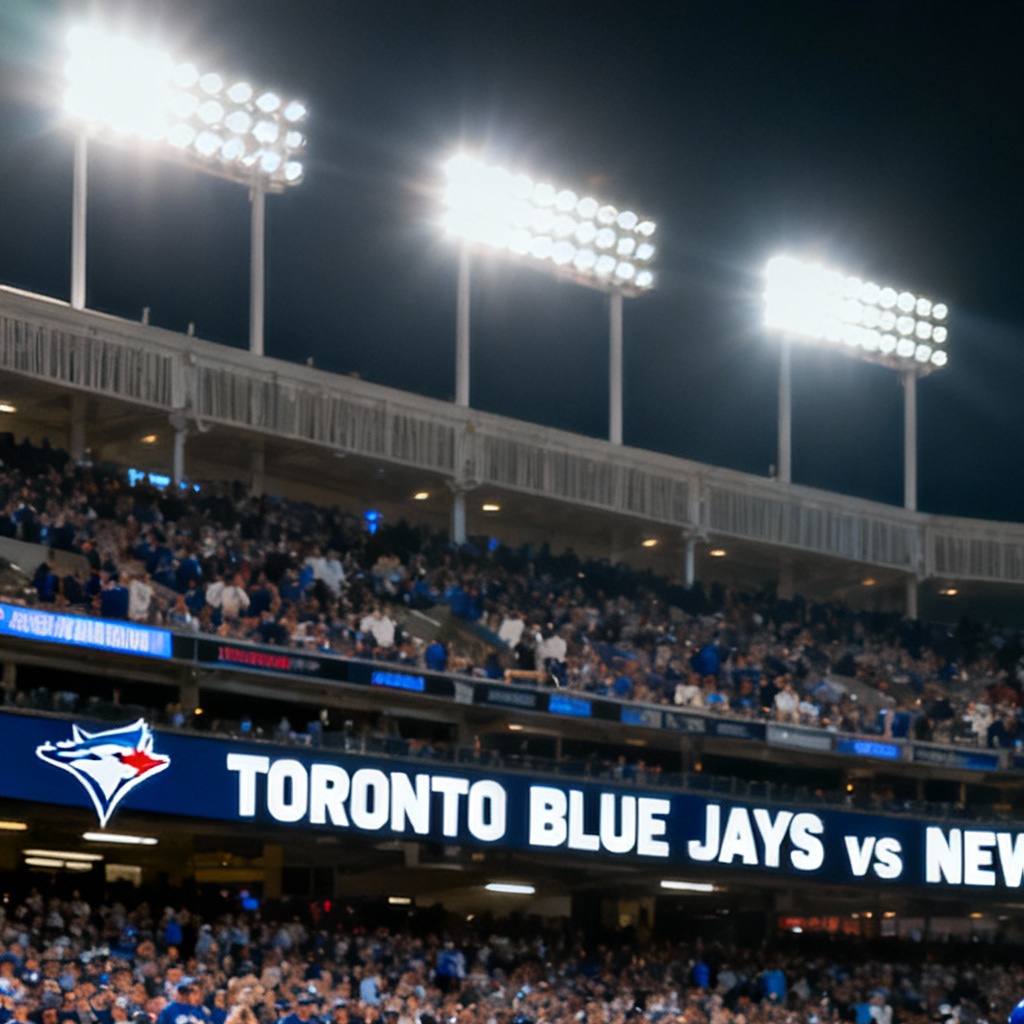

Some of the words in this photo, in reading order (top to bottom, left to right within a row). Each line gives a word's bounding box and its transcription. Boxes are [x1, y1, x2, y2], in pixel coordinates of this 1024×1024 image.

[226, 752, 507, 842] TORONTO
[529, 786, 670, 857] BLUE
[687, 803, 824, 871] JAYS
